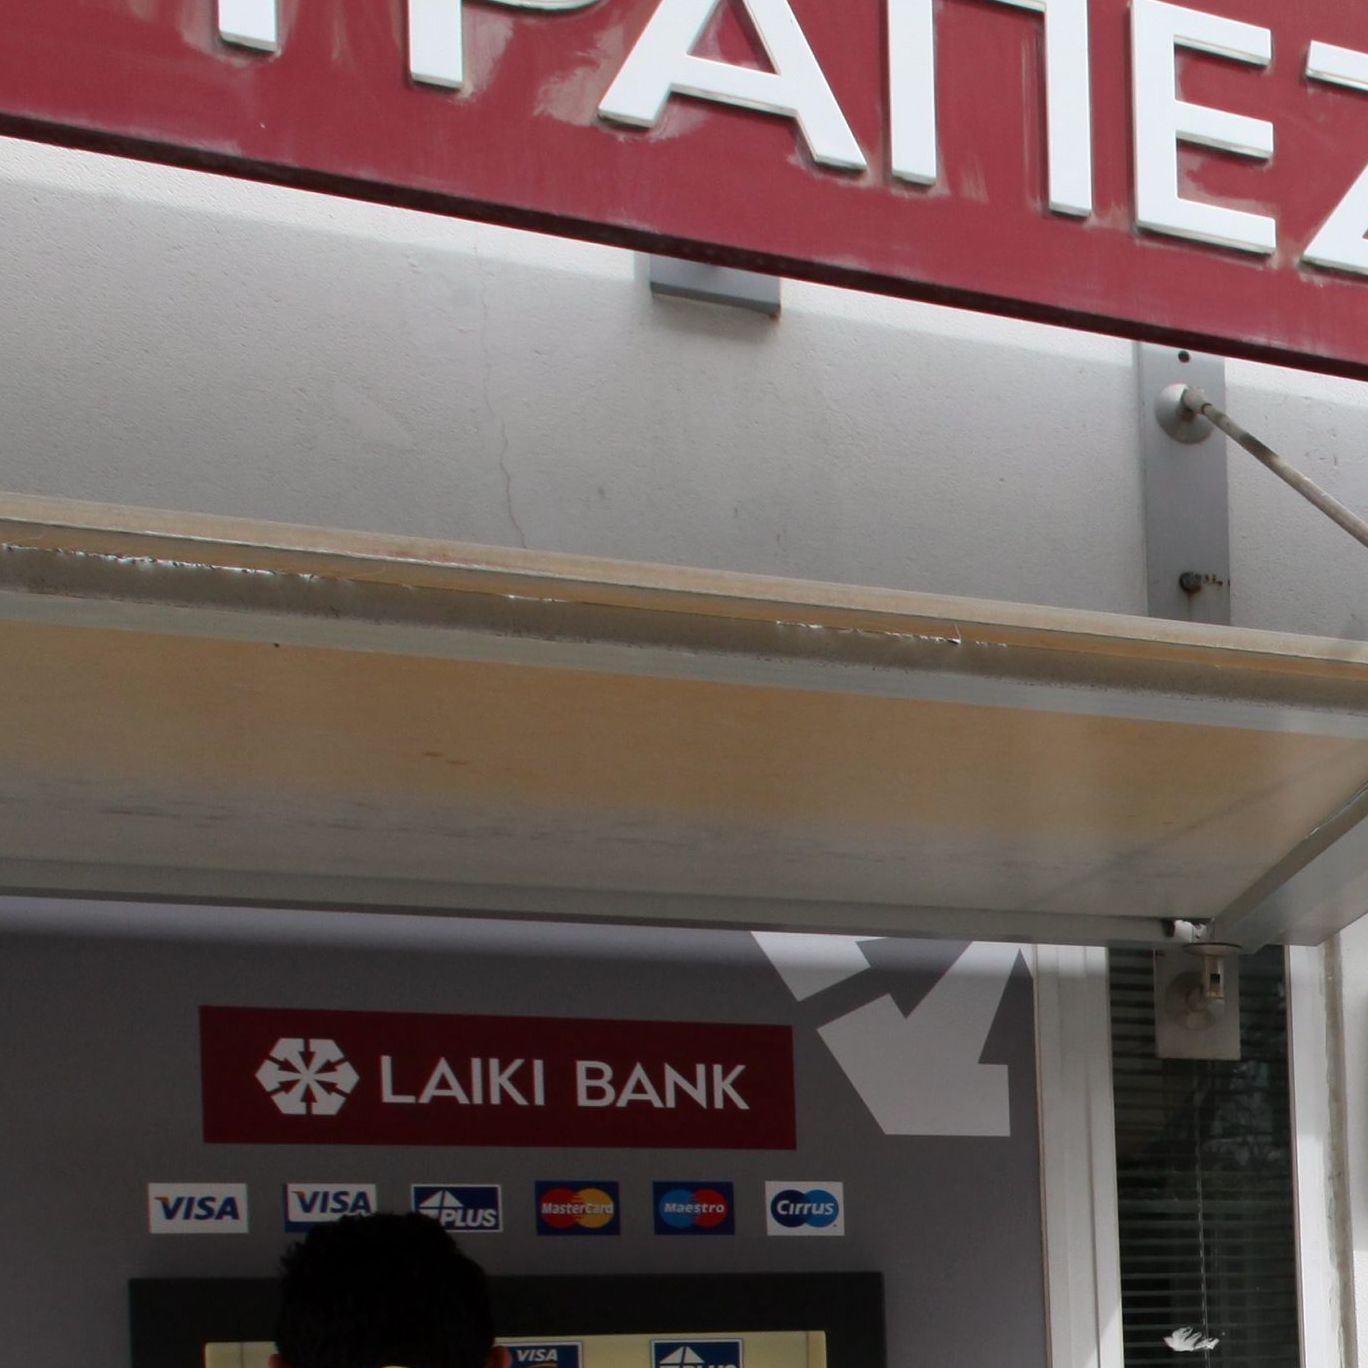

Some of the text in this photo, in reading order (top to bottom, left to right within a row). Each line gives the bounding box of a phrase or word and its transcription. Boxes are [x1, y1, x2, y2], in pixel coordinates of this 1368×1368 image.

[380, 1055, 750, 1111] LAIKI BANK
[154, 1196, 240, 1221] VISA
[293, 1190, 373, 1215] VISA
[541, 1202, 614, 1215] MasterCard
[664, 1202, 725, 1214] Maestro
[776, 1199, 835, 1216] Cirrus
[441, 1209, 498, 1228] PLUS
[517, 1348, 558, 1362] VISA
